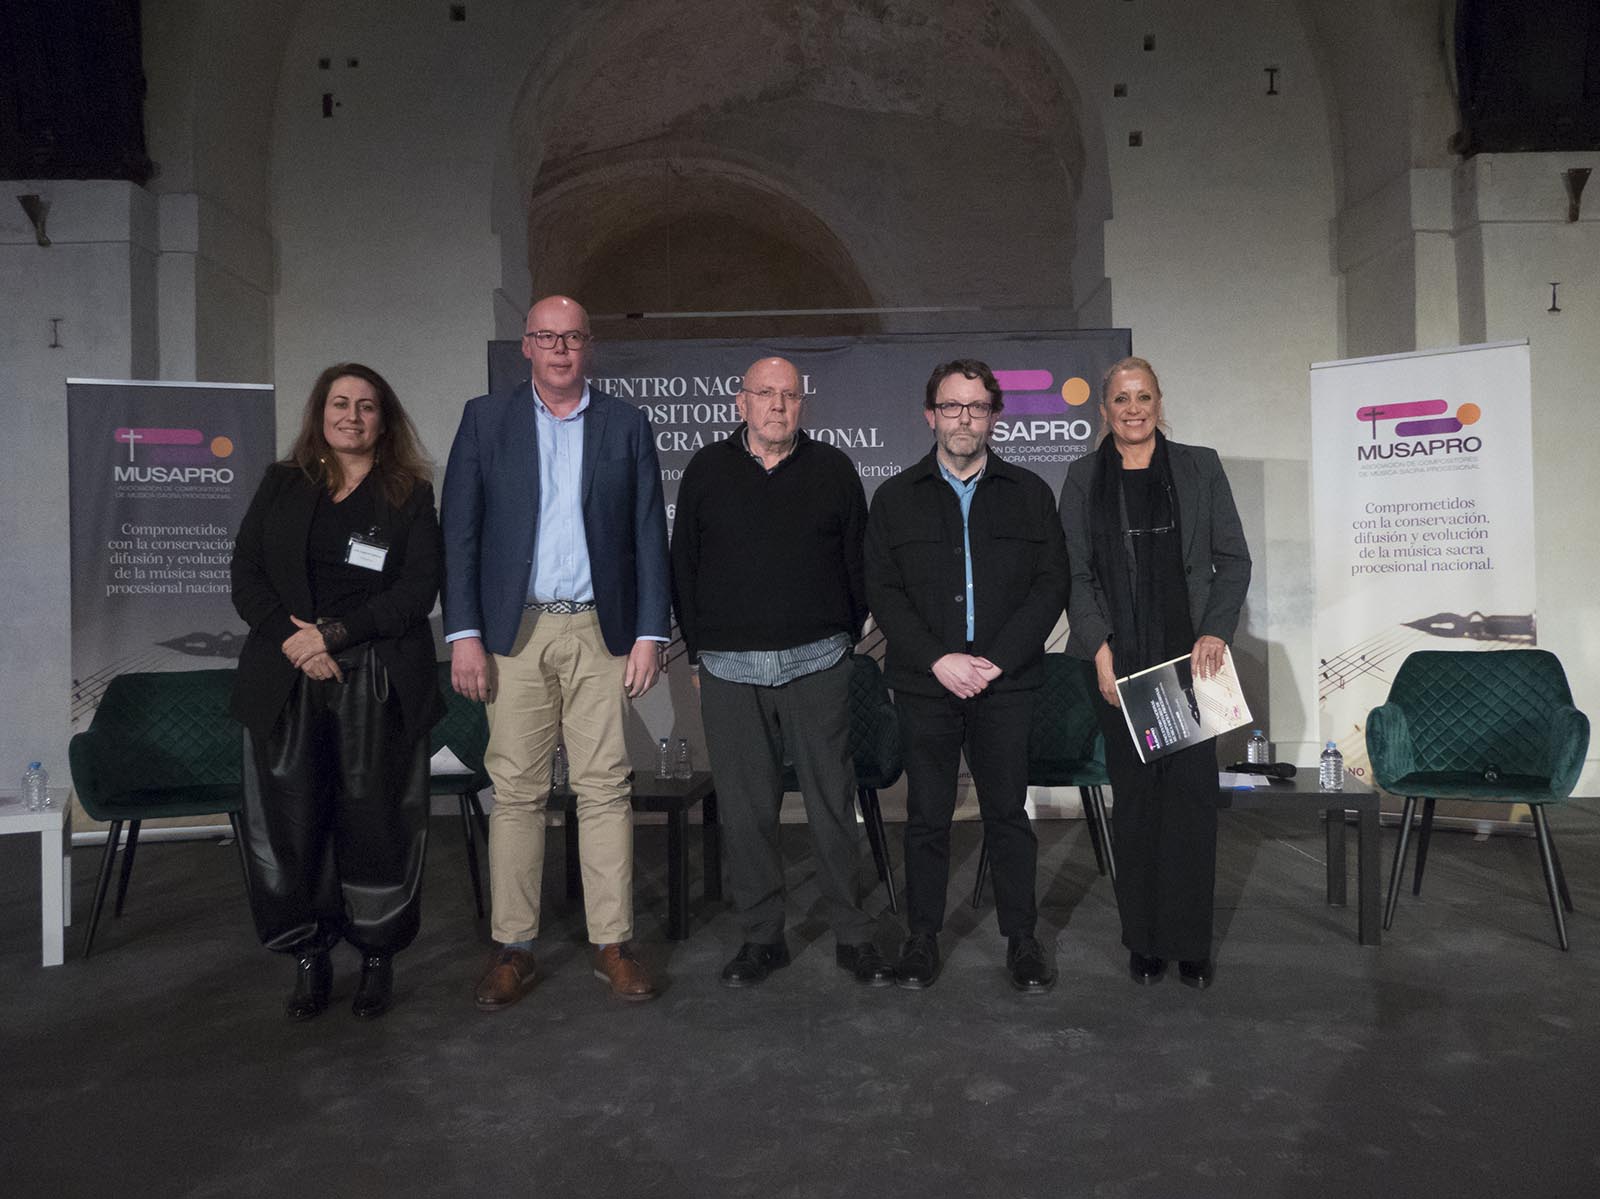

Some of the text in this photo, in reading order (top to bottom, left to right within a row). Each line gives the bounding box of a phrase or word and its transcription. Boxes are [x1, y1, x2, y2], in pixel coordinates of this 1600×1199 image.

[991, 420, 1092, 442] SAPRO
[656, 431, 704, 451] CRA
[1357, 436, 1482, 461] MUSAPRO
[1004, 446, 1017, 454] DE
[1018, 445, 1088, 454] COMPOSITORES
[1000, 454, 1086, 463] ACRA PROCESION
[114, 466, 234, 484] MUSAPRO
[856, 461, 902, 477] lencia
[1365, 497, 1476, 515] Comprometidos
[121, 523, 228, 538] Comprometidos
[1352, 519, 1377, 530] con
[1380, 516, 1391, 529] la
[107, 541, 133, 550] con
[136, 538, 148, 550] la
[1354, 527, 1489, 548] difusión y evolución
[1359, 543, 1485, 559] de la música sacra
[109, 551, 163, 565] difusión
[166, 555, 176, 570] y
[1351, 557, 1495, 577] procesional nacional.
[114, 567, 132, 579] de
[135, 567, 146, 579] la
[149, 565, 197, 579] música
[106, 582, 232, 597] procesional nacion
